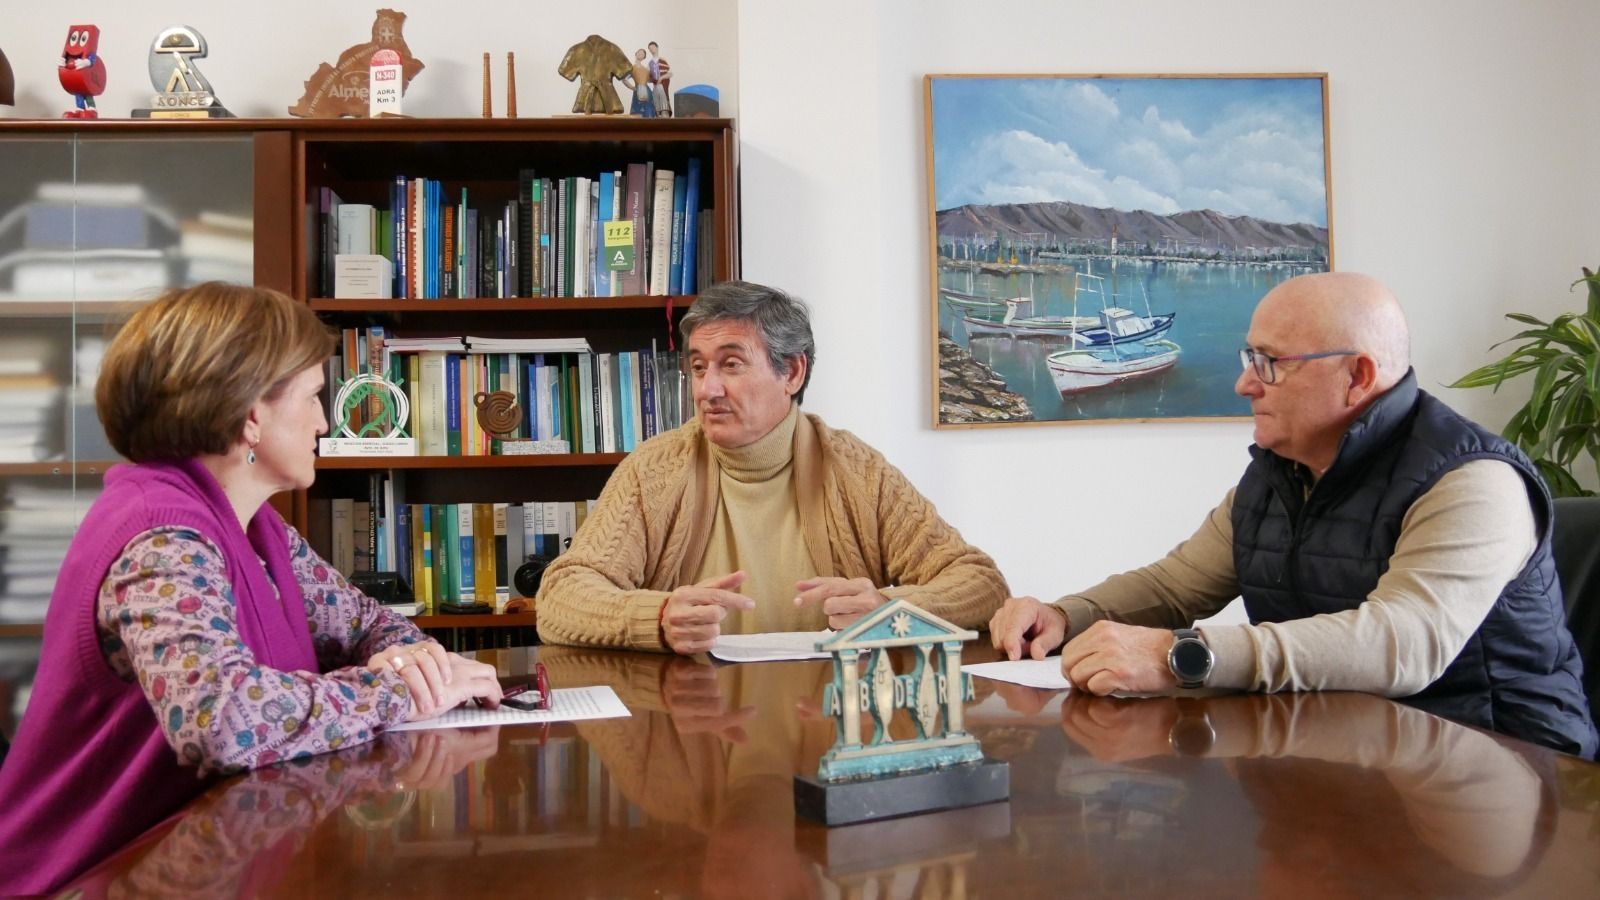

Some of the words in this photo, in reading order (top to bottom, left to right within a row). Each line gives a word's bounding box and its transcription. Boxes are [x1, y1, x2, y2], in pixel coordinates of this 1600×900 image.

[376, 71, 395, 80] N-340
[328, 84, 369, 102] Alme
[608, 226, 631, 237] 112
